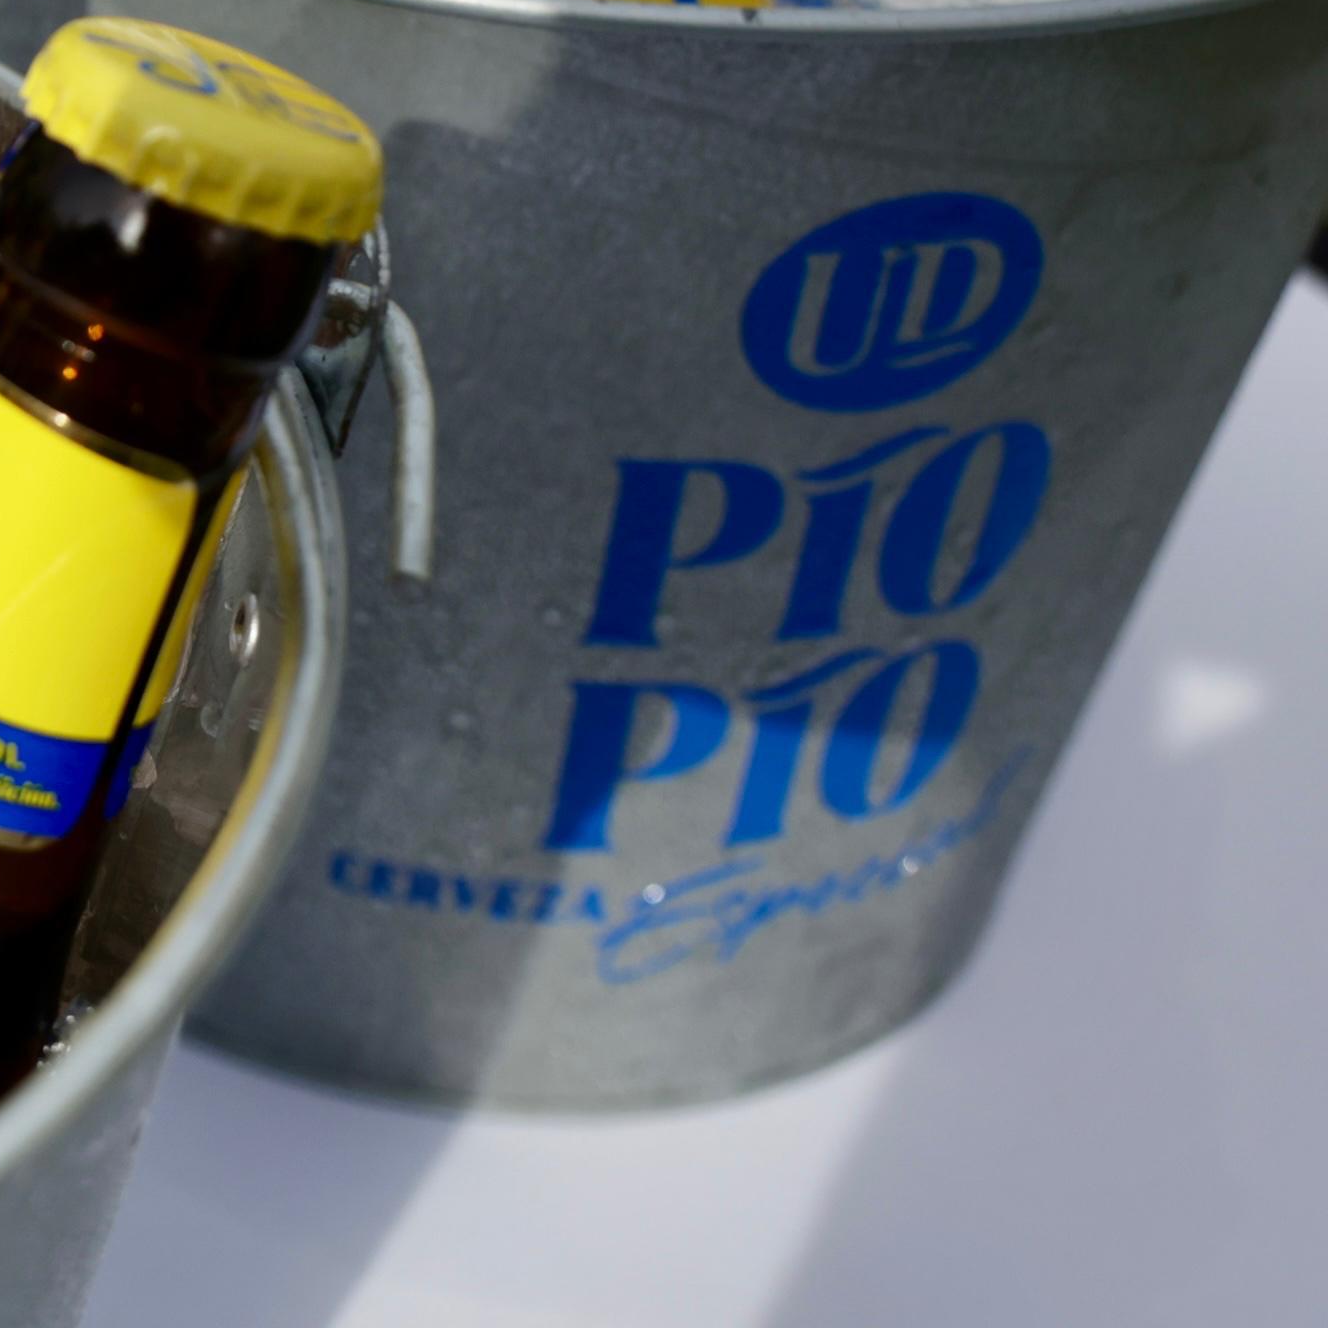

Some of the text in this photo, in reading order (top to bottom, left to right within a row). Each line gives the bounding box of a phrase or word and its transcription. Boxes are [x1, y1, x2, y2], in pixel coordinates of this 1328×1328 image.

[785, 238, 1004, 377] UD
[580, 421, 1052, 648] PÍO
[543, 639, 981, 854] PÍO
[328, 848, 606, 924] CERVEZA
